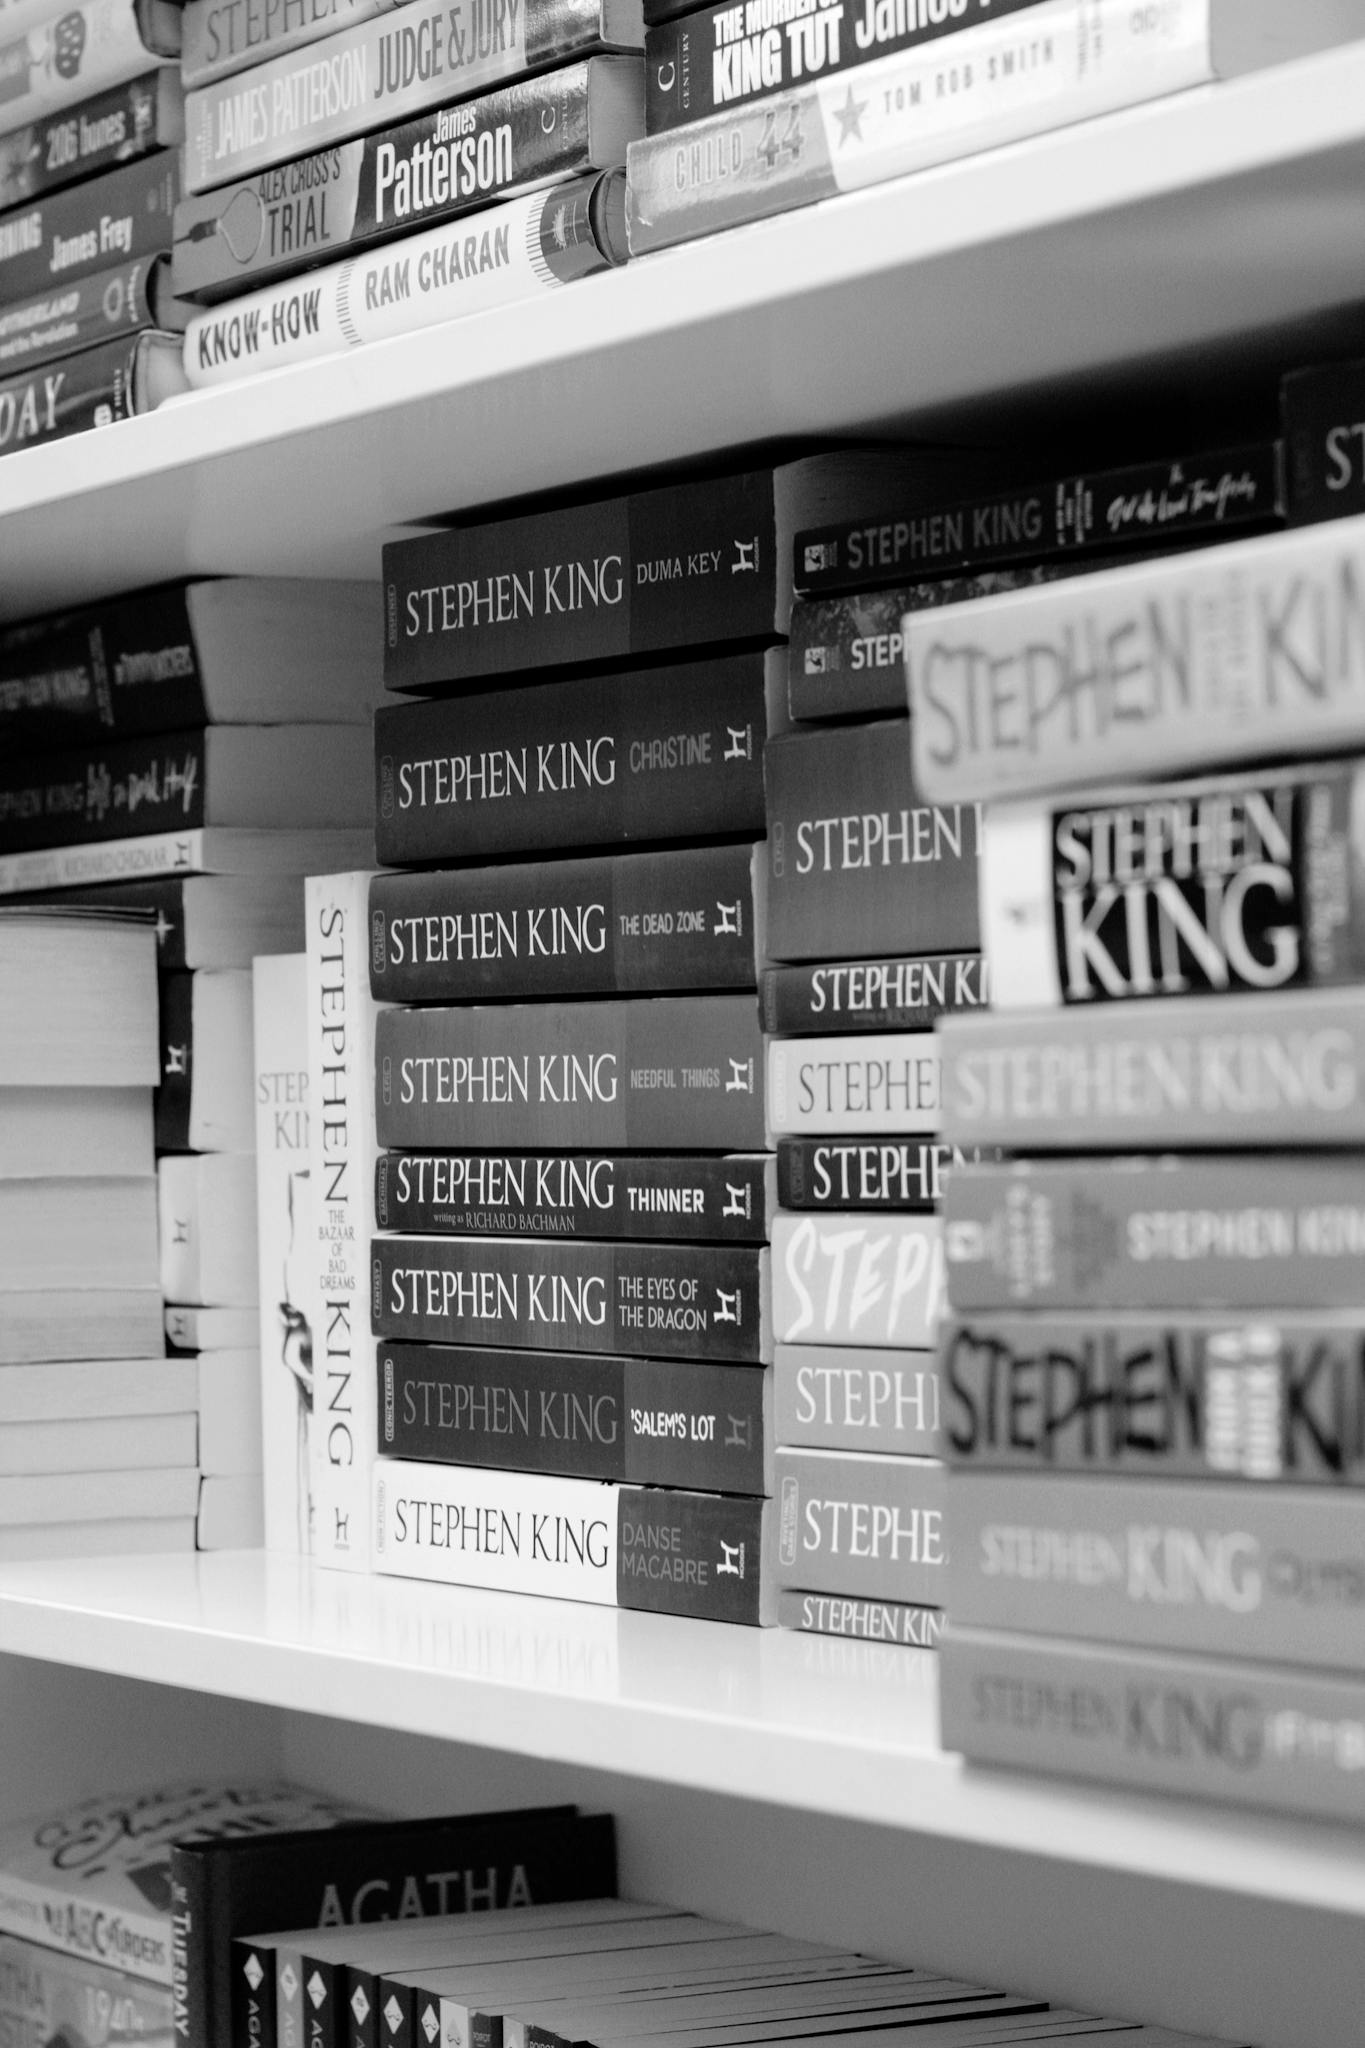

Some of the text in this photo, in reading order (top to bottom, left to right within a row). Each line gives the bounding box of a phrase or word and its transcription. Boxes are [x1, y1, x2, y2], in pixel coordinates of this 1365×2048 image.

[374, 0, 519, 99] JUDGE & JURY
[712, 5, 744, 47] THE
[713, 4, 844, 105] KING TUT
[214, 84, 268, 160] JAMES
[272, 44, 368, 138] PATTERSON
[682, 32, 690, 109] CENTURY
[884, 81, 921, 115] TOM
[936, 64, 973, 99] ROB
[988, 38, 1054, 81] SMITH
[433, 106, 477, 146] James
[674, 102, 804, 192] CHILD 44
[259, 148, 342, 203] ALEX CROSS'S
[376, 123, 513, 223] Patterson
[50, 229, 98, 273] James
[100, 215, 133, 253] Frey
[268, 192, 330, 257] TRIAL
[198, 288, 321, 369] KNOW-HOW
[365, 258, 411, 310] RAM
[418, 224, 511, 292] CHARAN
[847, 511, 963, 570] STEPHEN
[972, 499, 1042, 548] KING
[405, 550, 722, 637] STEPHEN KING DUMA KEY
[849, 634, 911, 671] STEP
[922, 598, 1193, 766] STEPHEN
[398, 747, 528, 810] STEPHEN
[537, 736, 616, 792] KING
[630, 732, 712, 774] CHRISTINE
[796, 803, 962, 874] STEPHEN
[1057, 786, 1295, 889] STEPHEN
[390, 904, 705, 964] STEPHEN KING THE DEAD ZONE
[1062, 862, 1299, 999] KING
[810, 961, 946, 1012] STEPHEN
[401, 1053, 721, 1103] STEPHEN KING NEEDFUL THINGS
[799, 1057, 943, 1114] STEPHE
[952, 1028, 1356, 1120] STEPHEN KING
[319, 905, 353, 1467] STEPHEN KING
[397, 1157, 615, 1209] STEPHEN KING
[627, 1187, 705, 1214] THINNER
[318, 1226, 356, 1241] BAZAAR
[328, 1209, 345, 1224] THE
[433, 1212, 575, 1232] writing as RICHARD BACHMAN
[328, 1259, 346, 1274] BAD
[331, 1242, 343, 1257] OF
[320, 1275, 356, 1291] DREAMS
[391, 1268, 607, 1326] STEPHEN KING
[618, 1276, 699, 1301] THE EYES OF
[619, 1305, 707, 1331] THE DRAGON
[403, 1380, 530, 1437] STEPHEN
[539, 1390, 618, 1444] KING
[630, 1408, 687, 1439] 'SALEM'S
[691, 1415, 716, 1442] LOT
[796, 1366, 940, 1432] STEPH
[396, 1498, 609, 1569] STEPHEN KING
[622, 1521, 682, 1552] DANSE
[622, 1554, 708, 1586] MACABRE
[1126, 1523, 1262, 1614] KING
[801, 1596, 899, 1641] STEPHEN
[1123, 1682, 1265, 1773] KING
[316, 1864, 533, 1929] AGATHA
